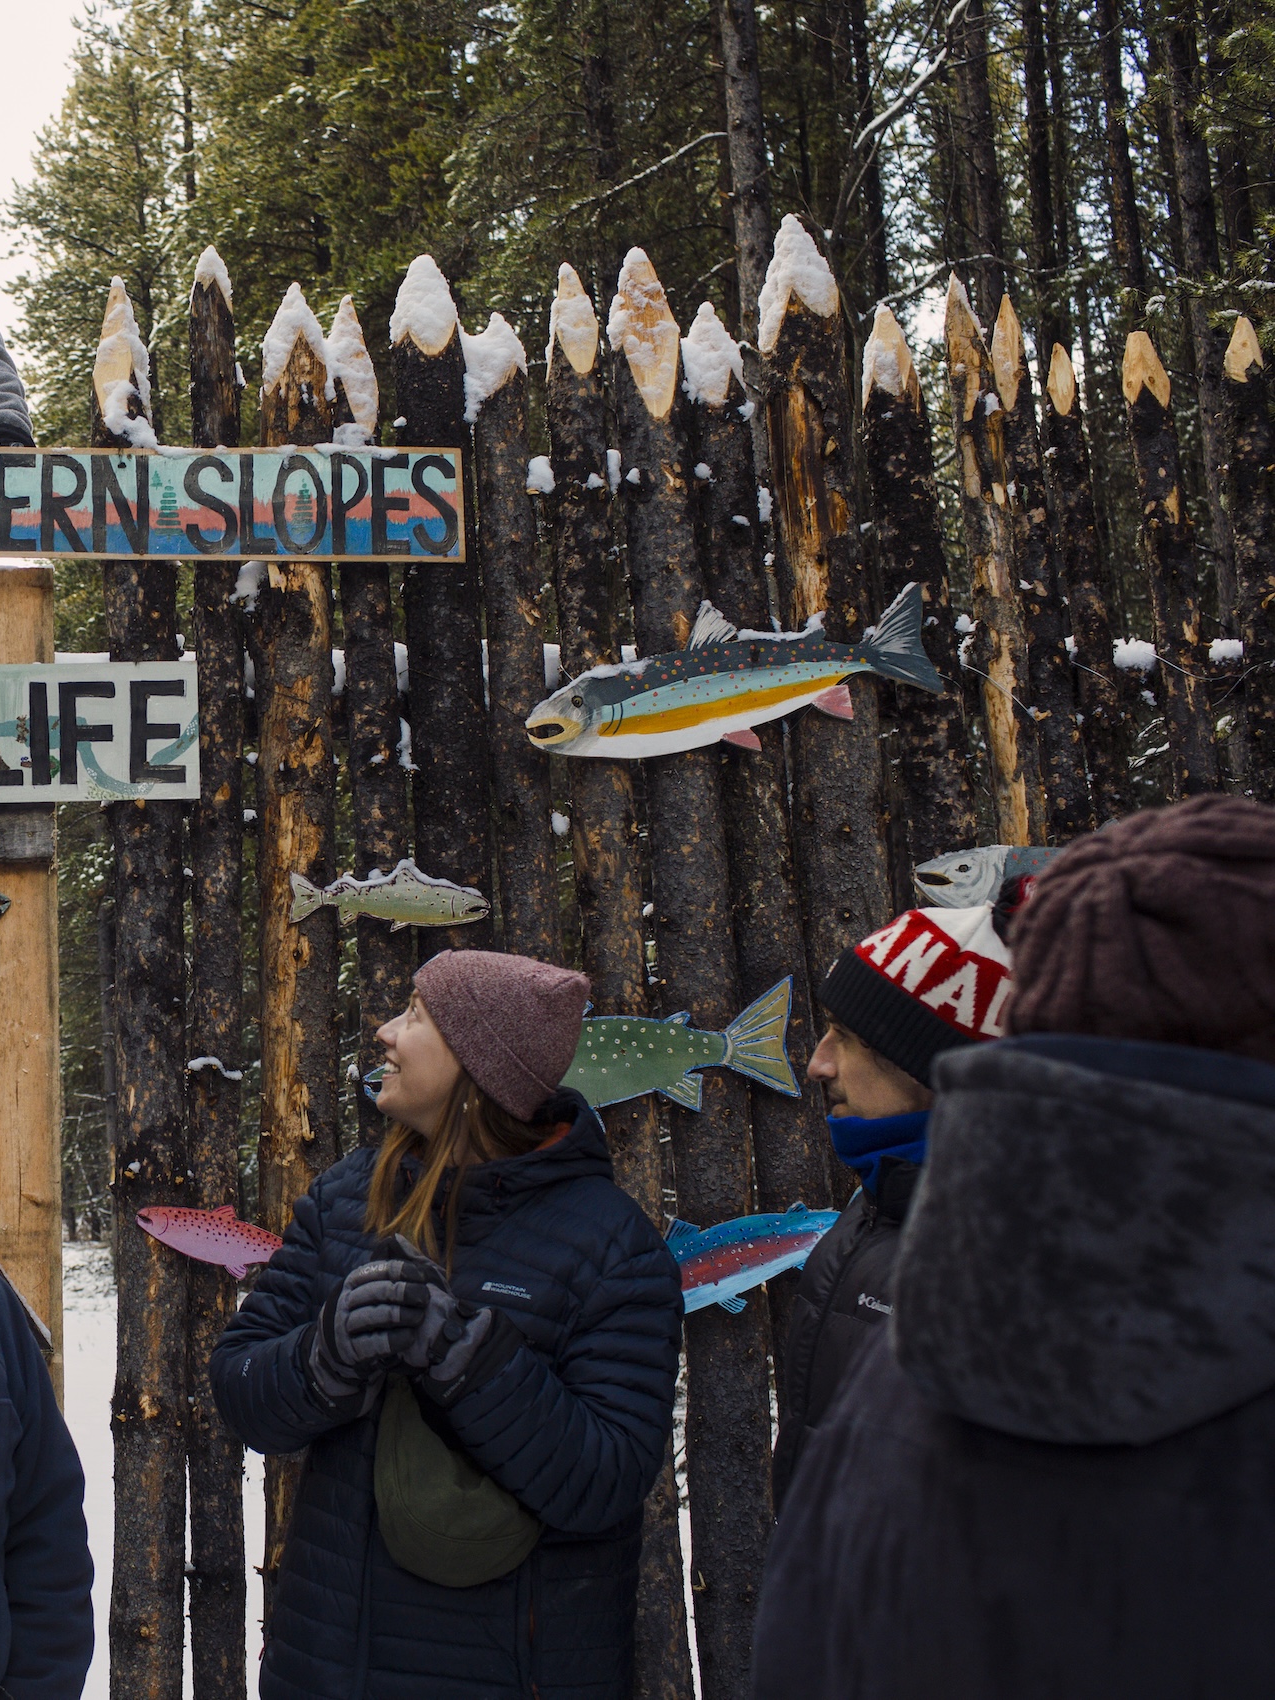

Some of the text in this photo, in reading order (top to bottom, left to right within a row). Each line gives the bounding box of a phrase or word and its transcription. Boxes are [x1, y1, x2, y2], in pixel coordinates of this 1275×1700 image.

[183, 453, 458, 557] SLOPES
[491, 1287, 532, 1300] WAREHOUSE
[492, 1282, 527, 1293] MOUNTAIN
[242, 1358, 251, 1377] 700
